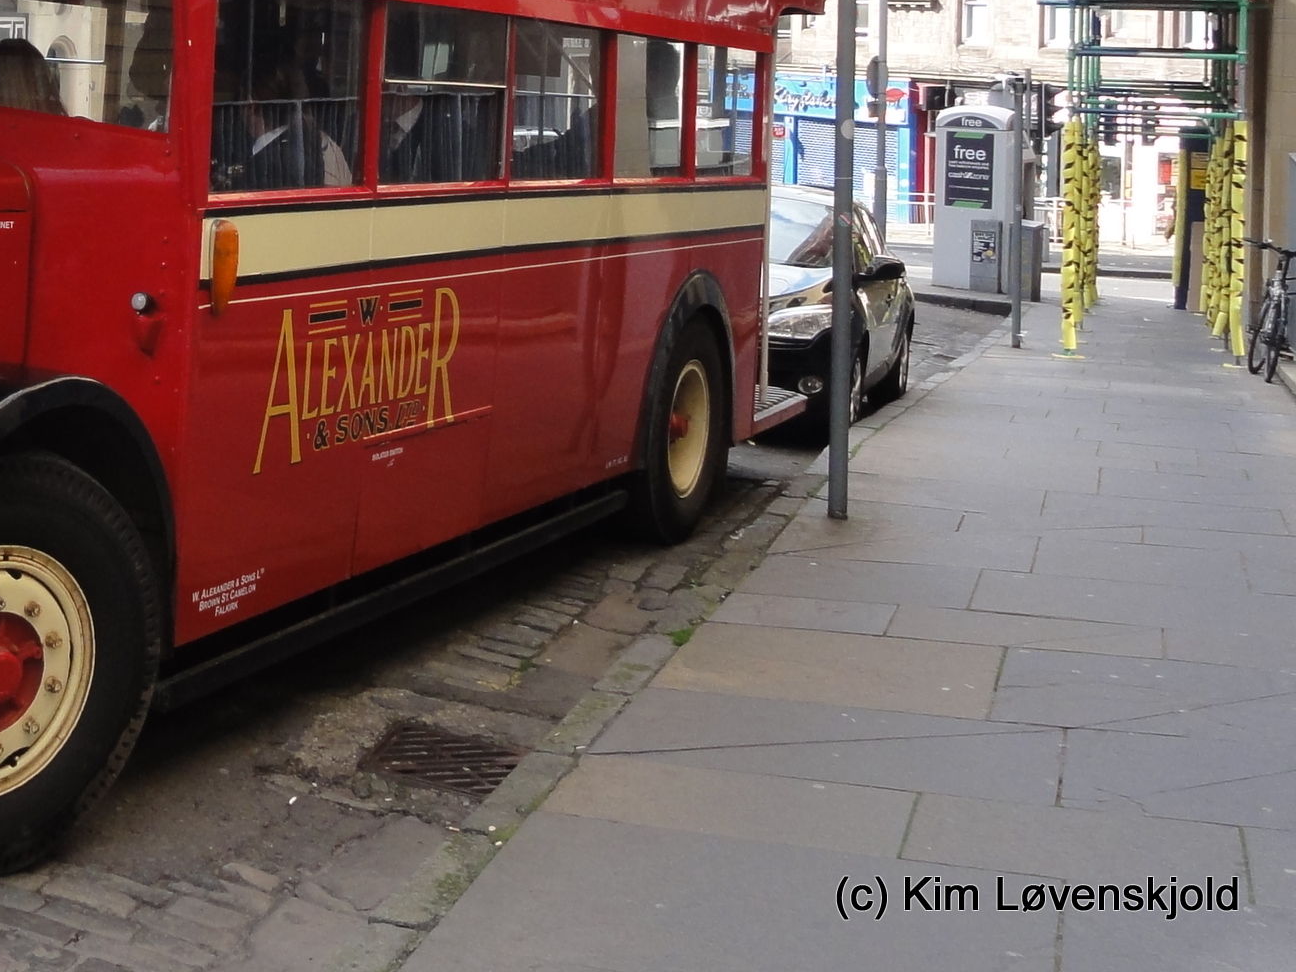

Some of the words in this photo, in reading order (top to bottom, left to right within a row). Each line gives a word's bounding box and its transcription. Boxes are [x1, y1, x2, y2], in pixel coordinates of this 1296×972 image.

[961, 116, 982, 127] free
[953, 144, 987, 161] free
[356, 295, 381, 327] W
[253, 287, 460, 475] ALEXANDER
[313, 418, 331, 452] &
